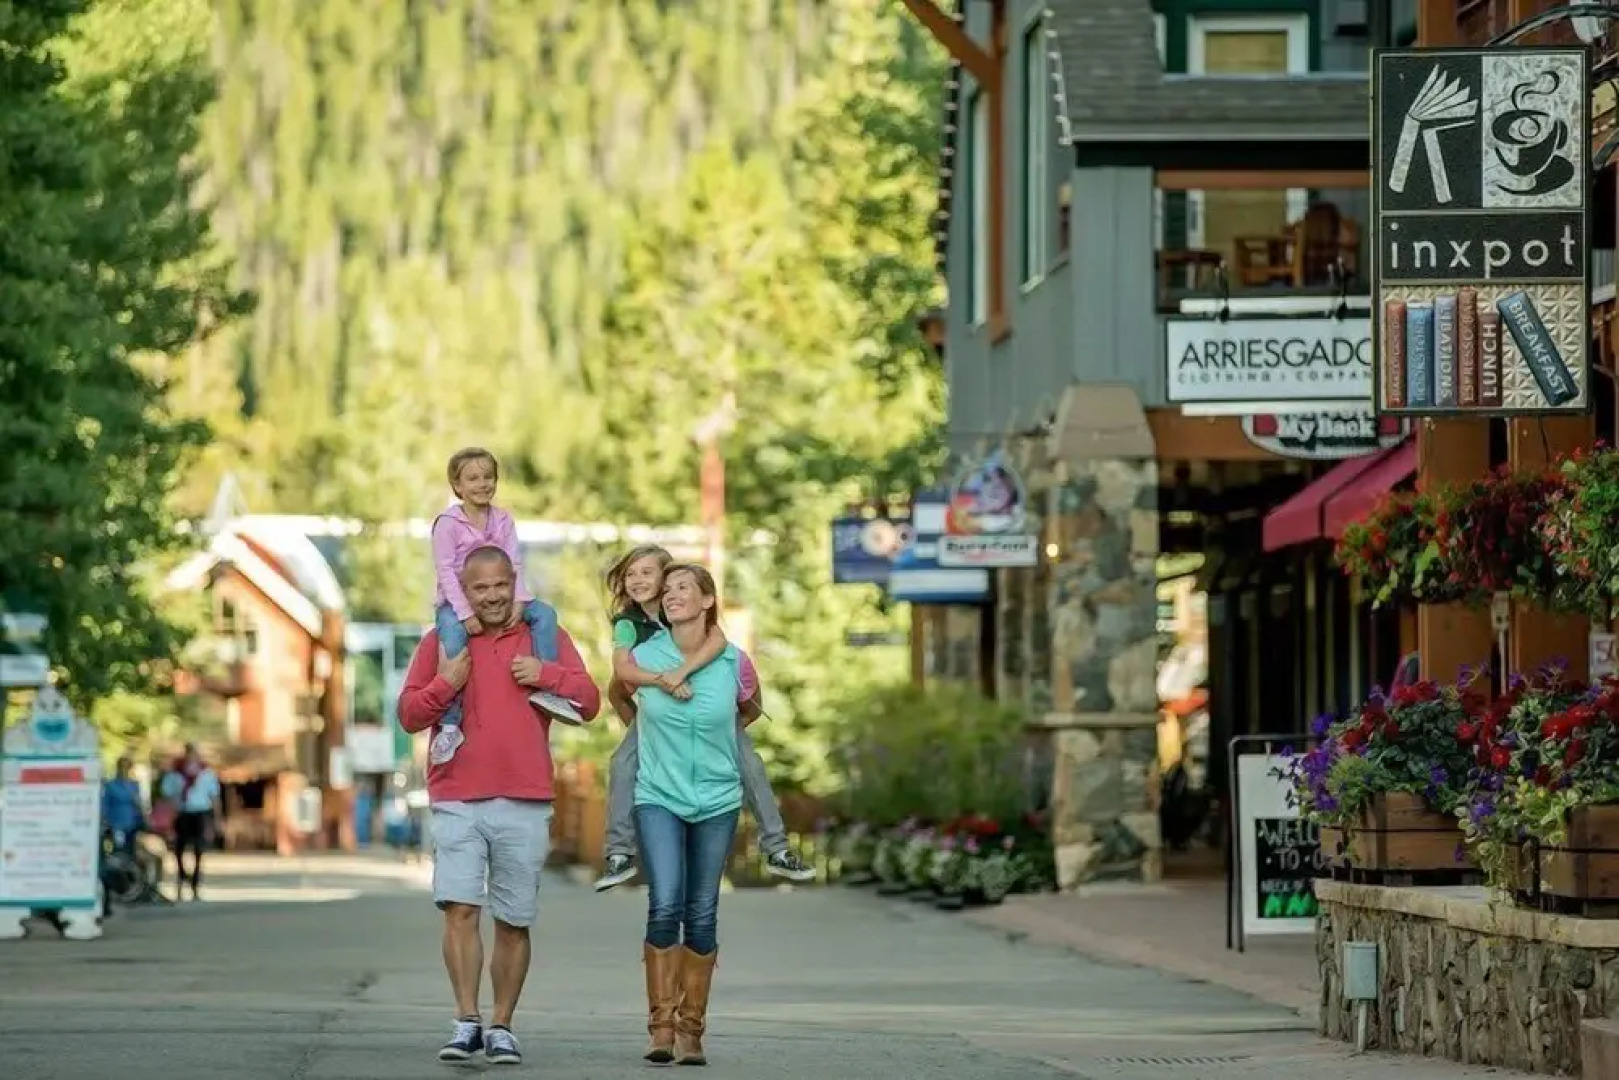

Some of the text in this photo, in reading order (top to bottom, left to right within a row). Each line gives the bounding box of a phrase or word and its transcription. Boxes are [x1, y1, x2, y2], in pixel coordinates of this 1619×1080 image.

[1390, 221, 1576, 279] inxpot
[1296, 370, 1372, 383] COMPAN
[1440, 306, 1453, 398] LIBATIONS
[1463, 330, 1474, 401] ESPRESSO
[1482, 322, 1497, 398] LUNCH
[1508, 301, 1568, 397] BREAKFAST
[1274, 849, 1300, 871] TO
